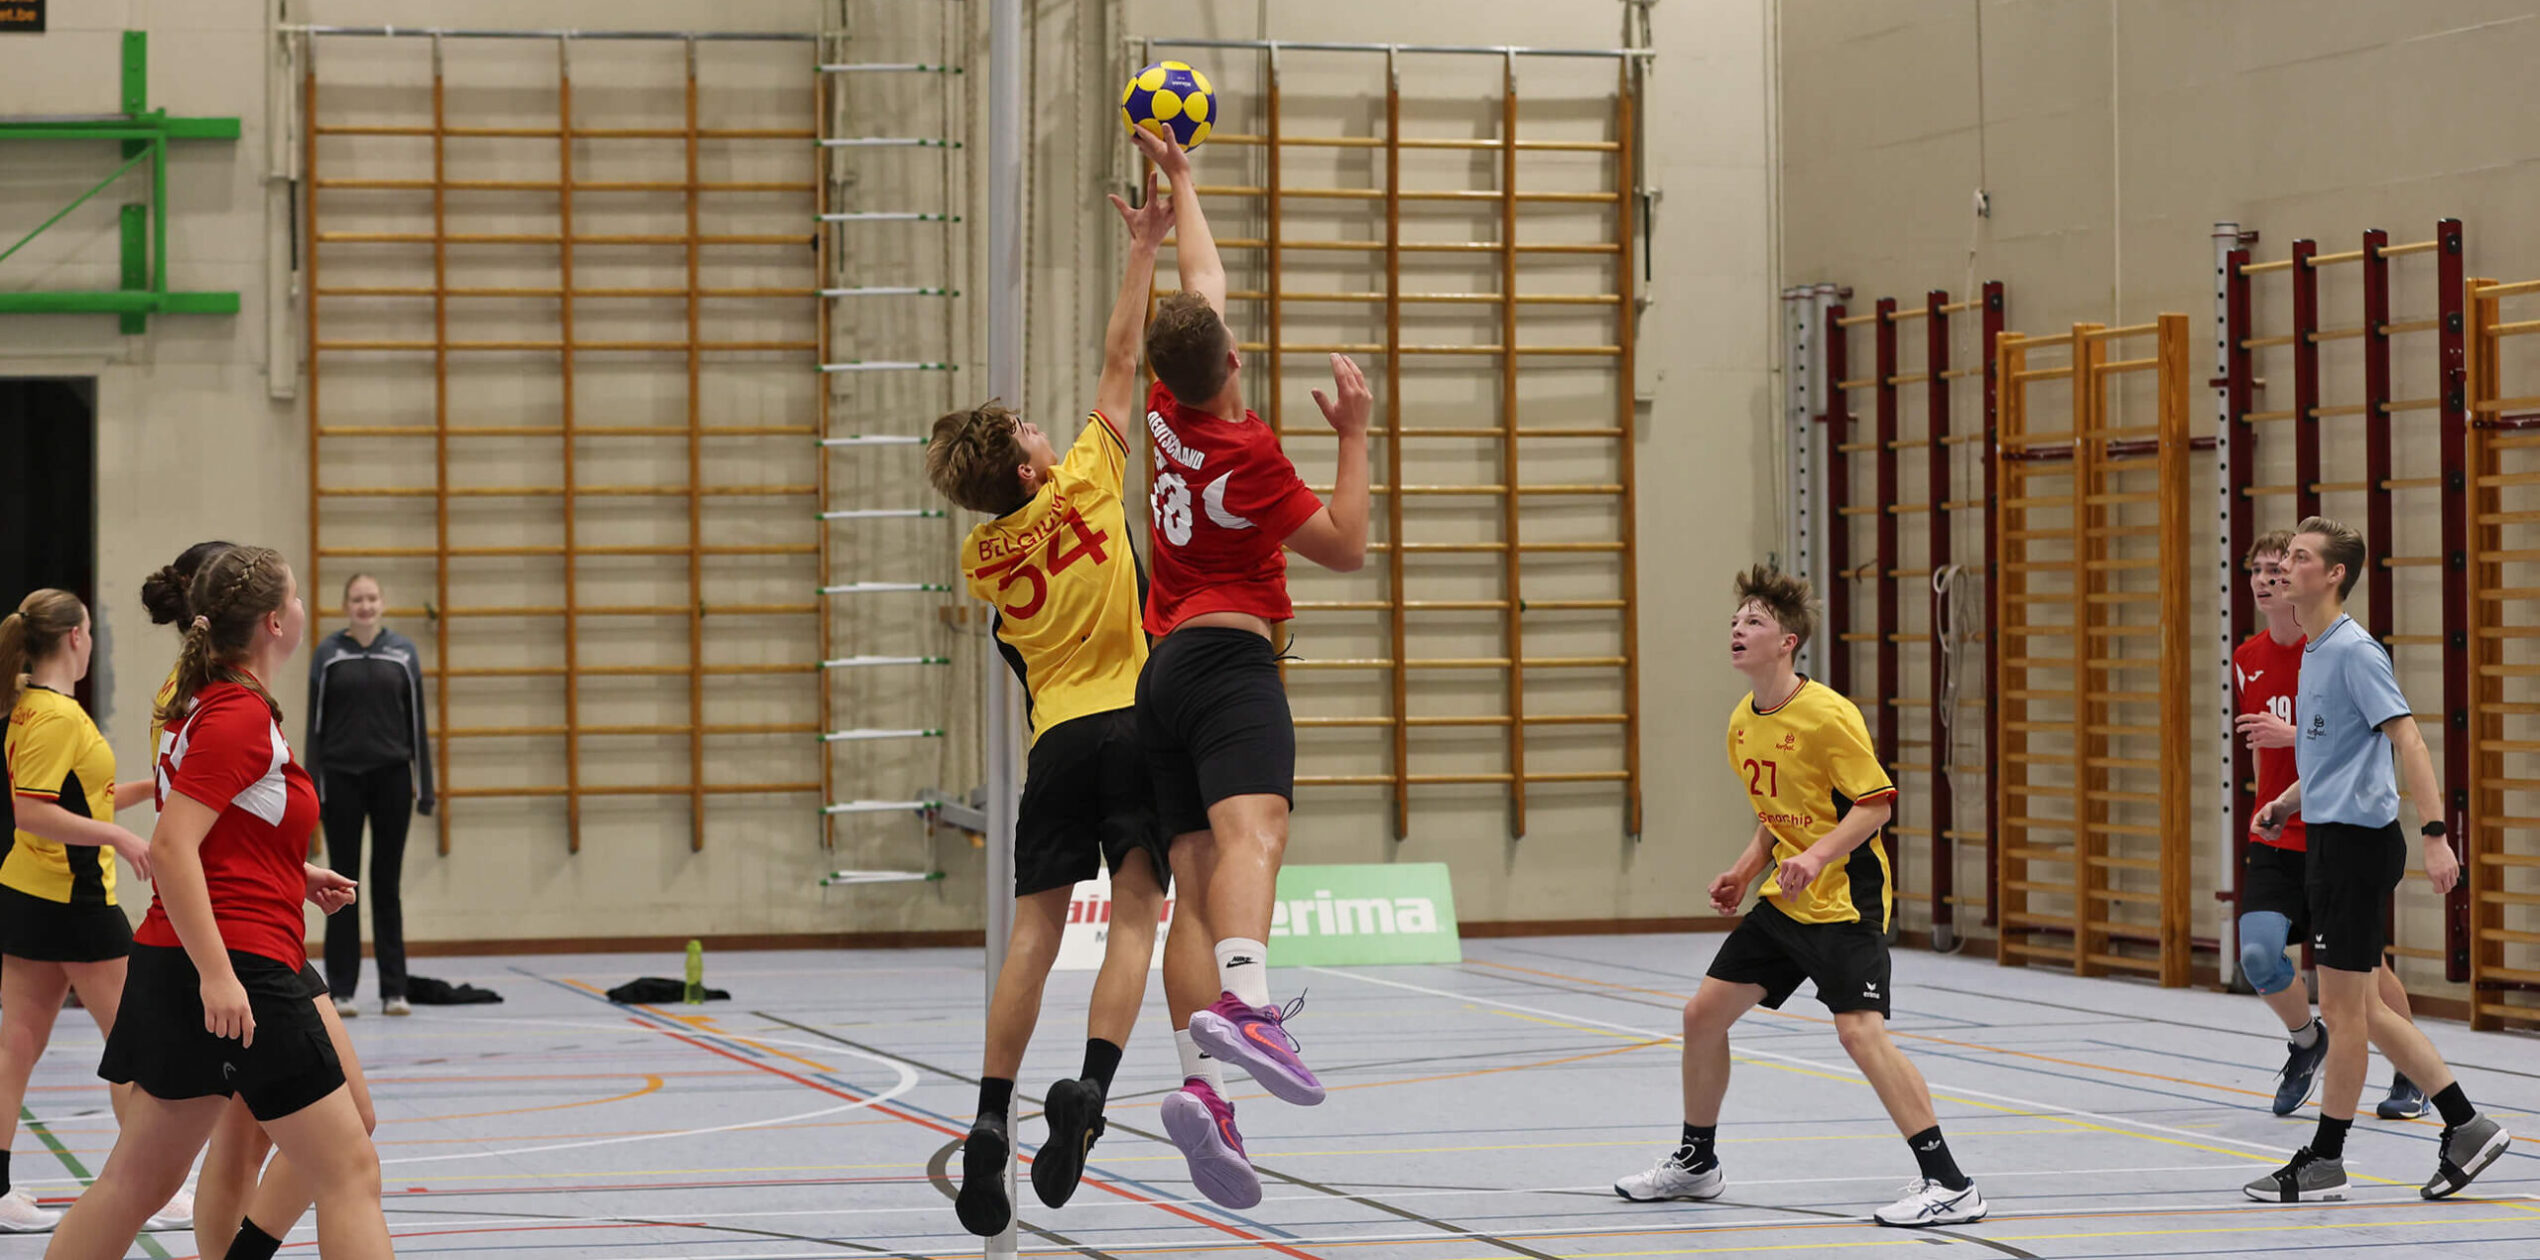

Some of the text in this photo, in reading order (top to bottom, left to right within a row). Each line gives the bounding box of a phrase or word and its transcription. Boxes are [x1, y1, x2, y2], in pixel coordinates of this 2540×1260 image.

[979, 493, 1066, 562] BELGIUM
[975, 506, 1108, 620] 34
[2266, 695, 2291, 726] 19
[1743, 759, 1777, 797] 27
[1270, 890, 1438, 936] erima
